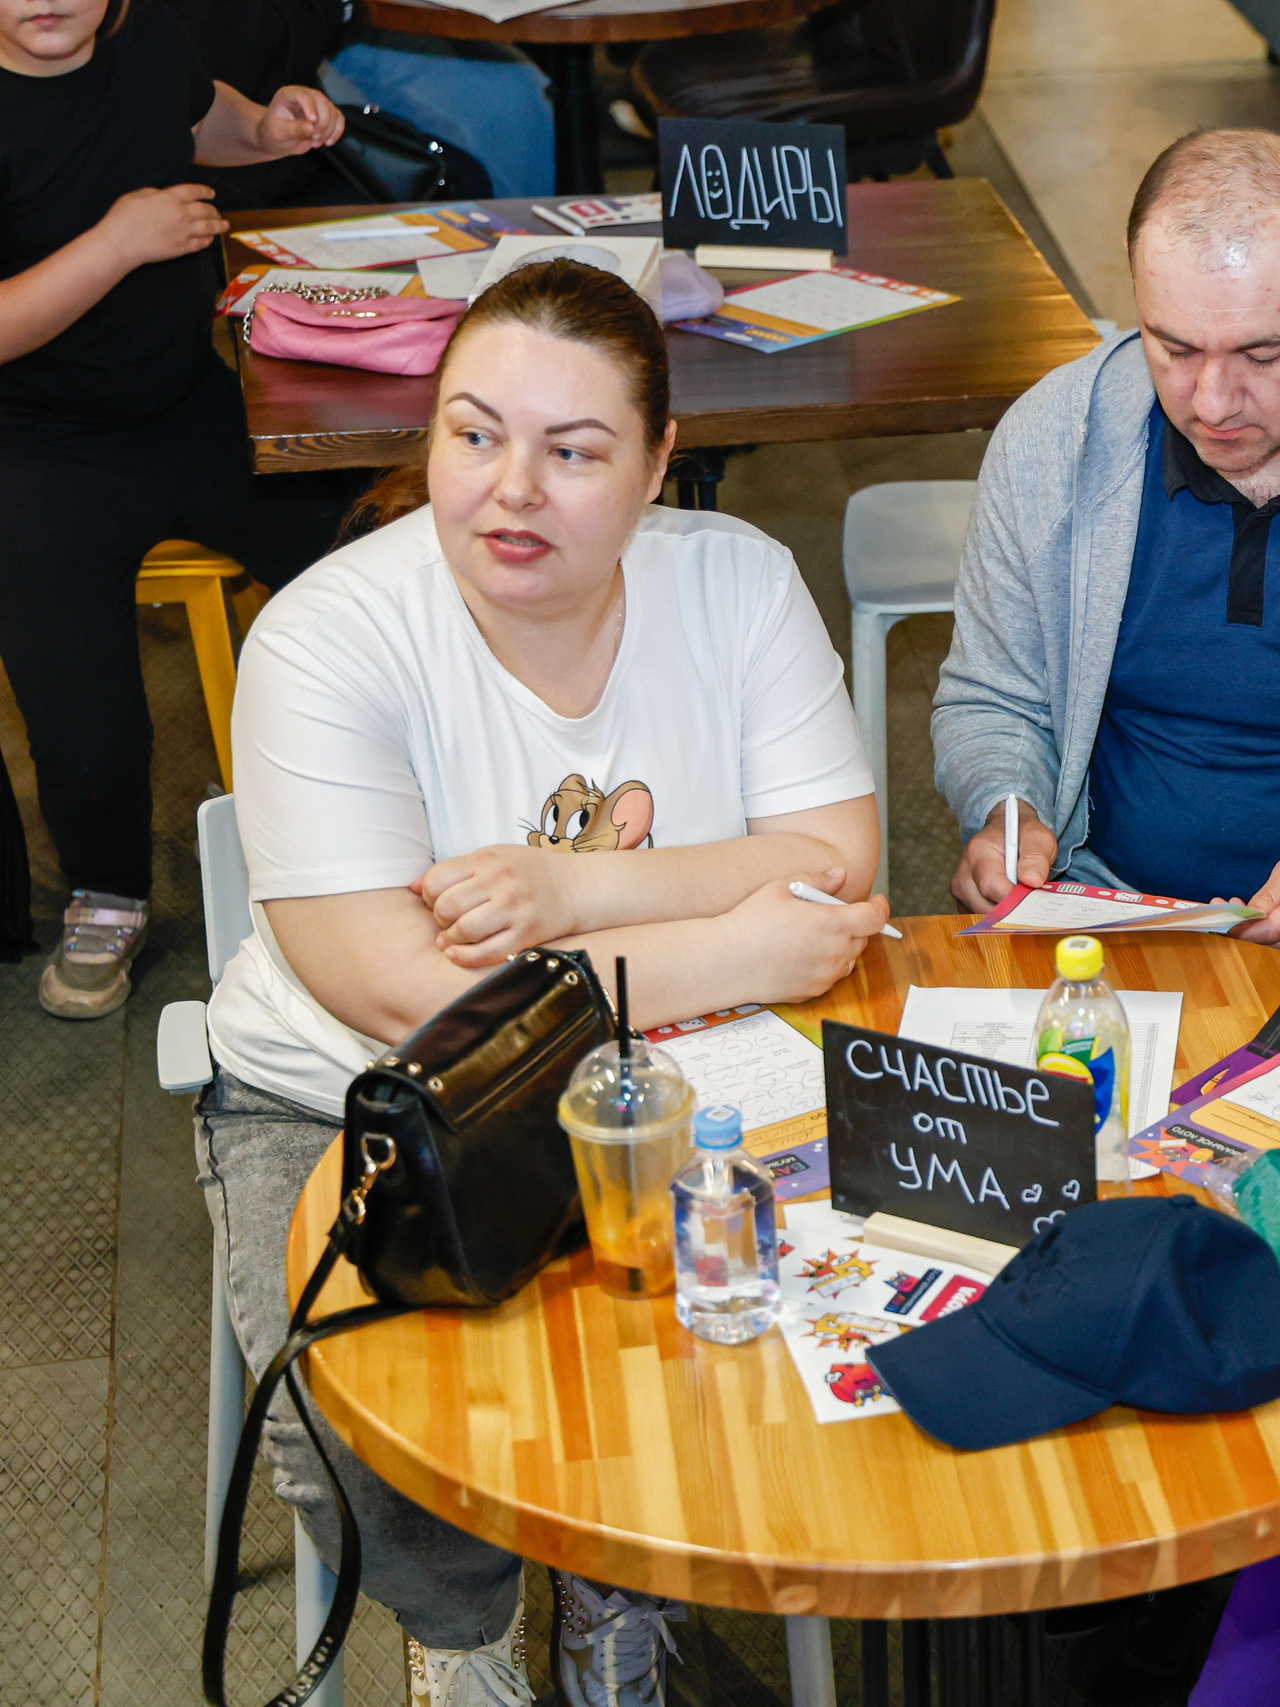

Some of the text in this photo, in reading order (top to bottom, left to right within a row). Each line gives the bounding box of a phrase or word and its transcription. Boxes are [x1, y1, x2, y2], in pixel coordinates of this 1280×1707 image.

[669, 143, 844, 231] ЛОДИРЫ
[1171, 1125, 1199, 1139] ЛОТО
[890, 1142, 1011, 1211] УМА
